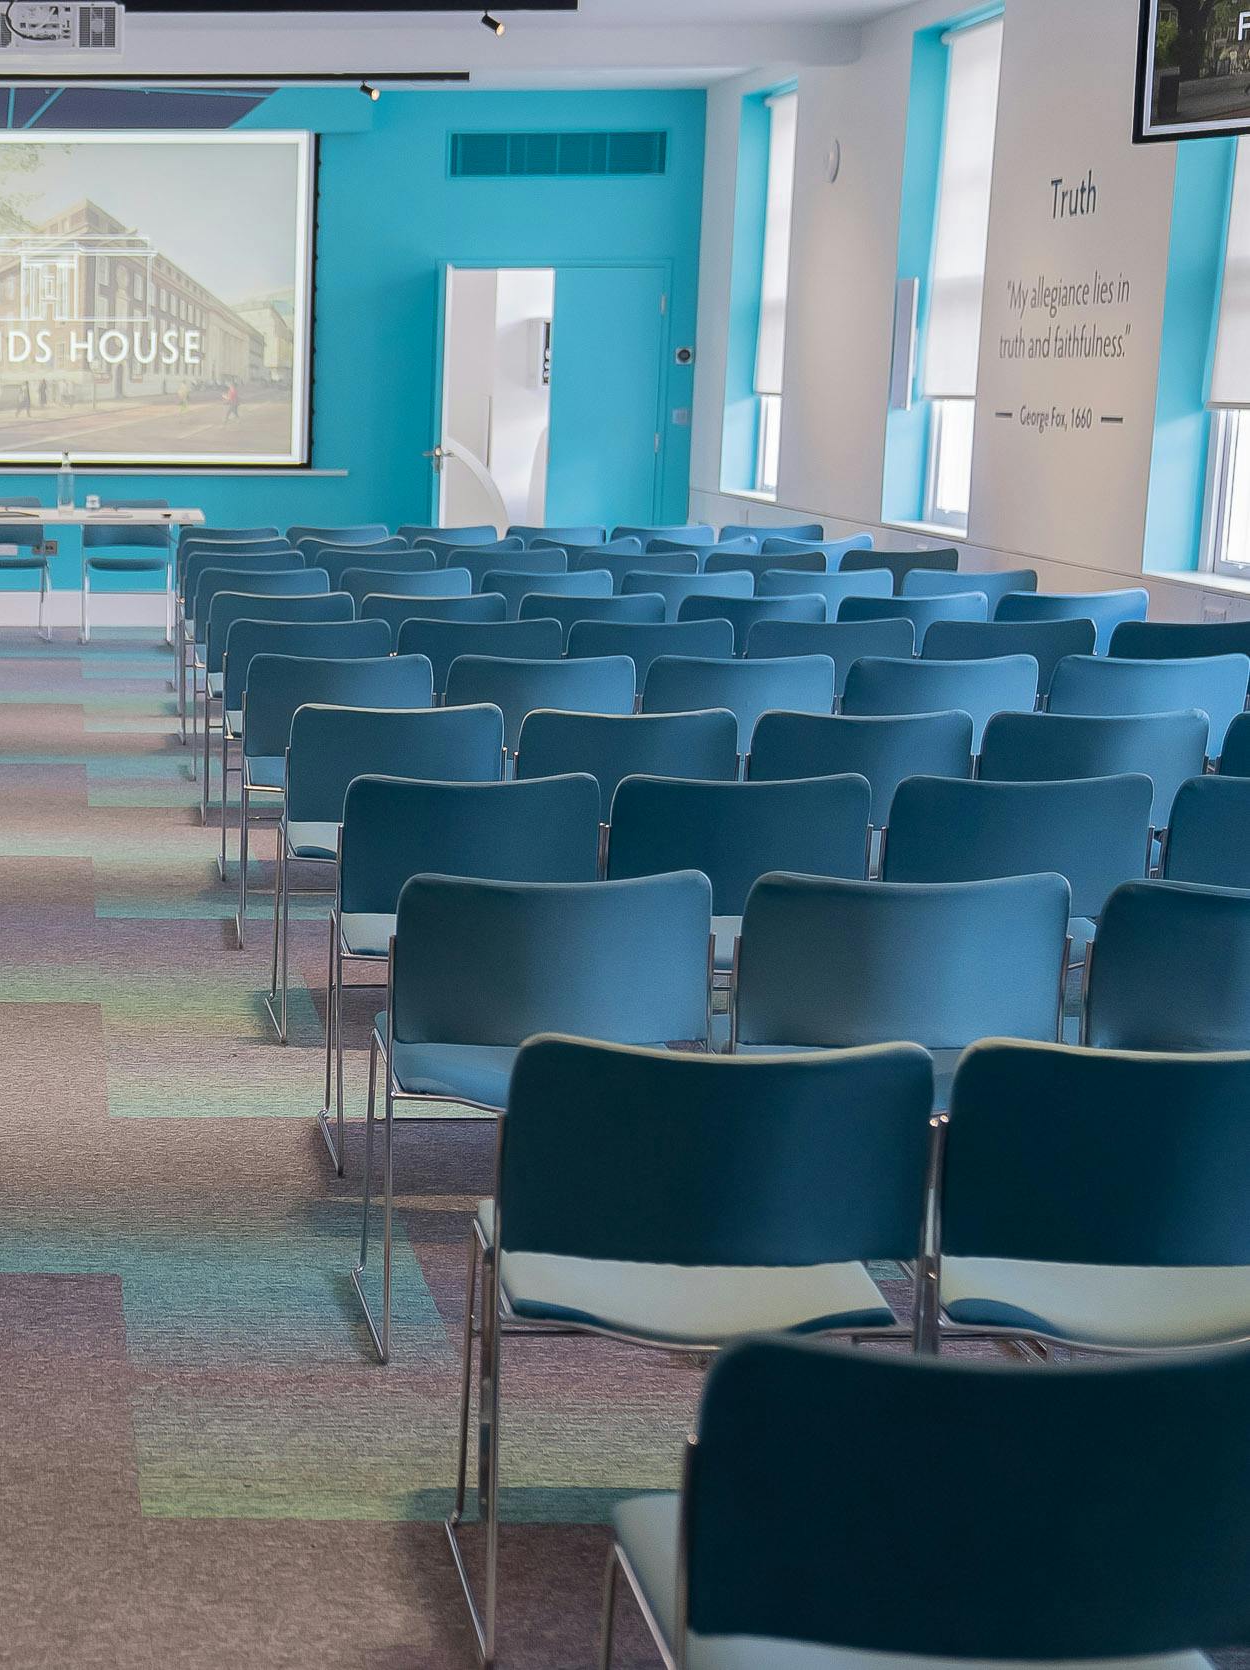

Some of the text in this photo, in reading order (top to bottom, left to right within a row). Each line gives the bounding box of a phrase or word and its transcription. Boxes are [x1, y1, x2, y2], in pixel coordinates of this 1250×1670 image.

[1051, 169, 1097, 219] Truth
[1030, 276, 1090, 318] allegiance
[1092, 270, 1114, 304] lies
[1117, 272, 1130, 303] in
[69, 329, 200, 364] HOUSE
[1000, 323, 1131, 359] truth and faithfulness."
[1019, 405, 1093, 433] George Fox, 1660
